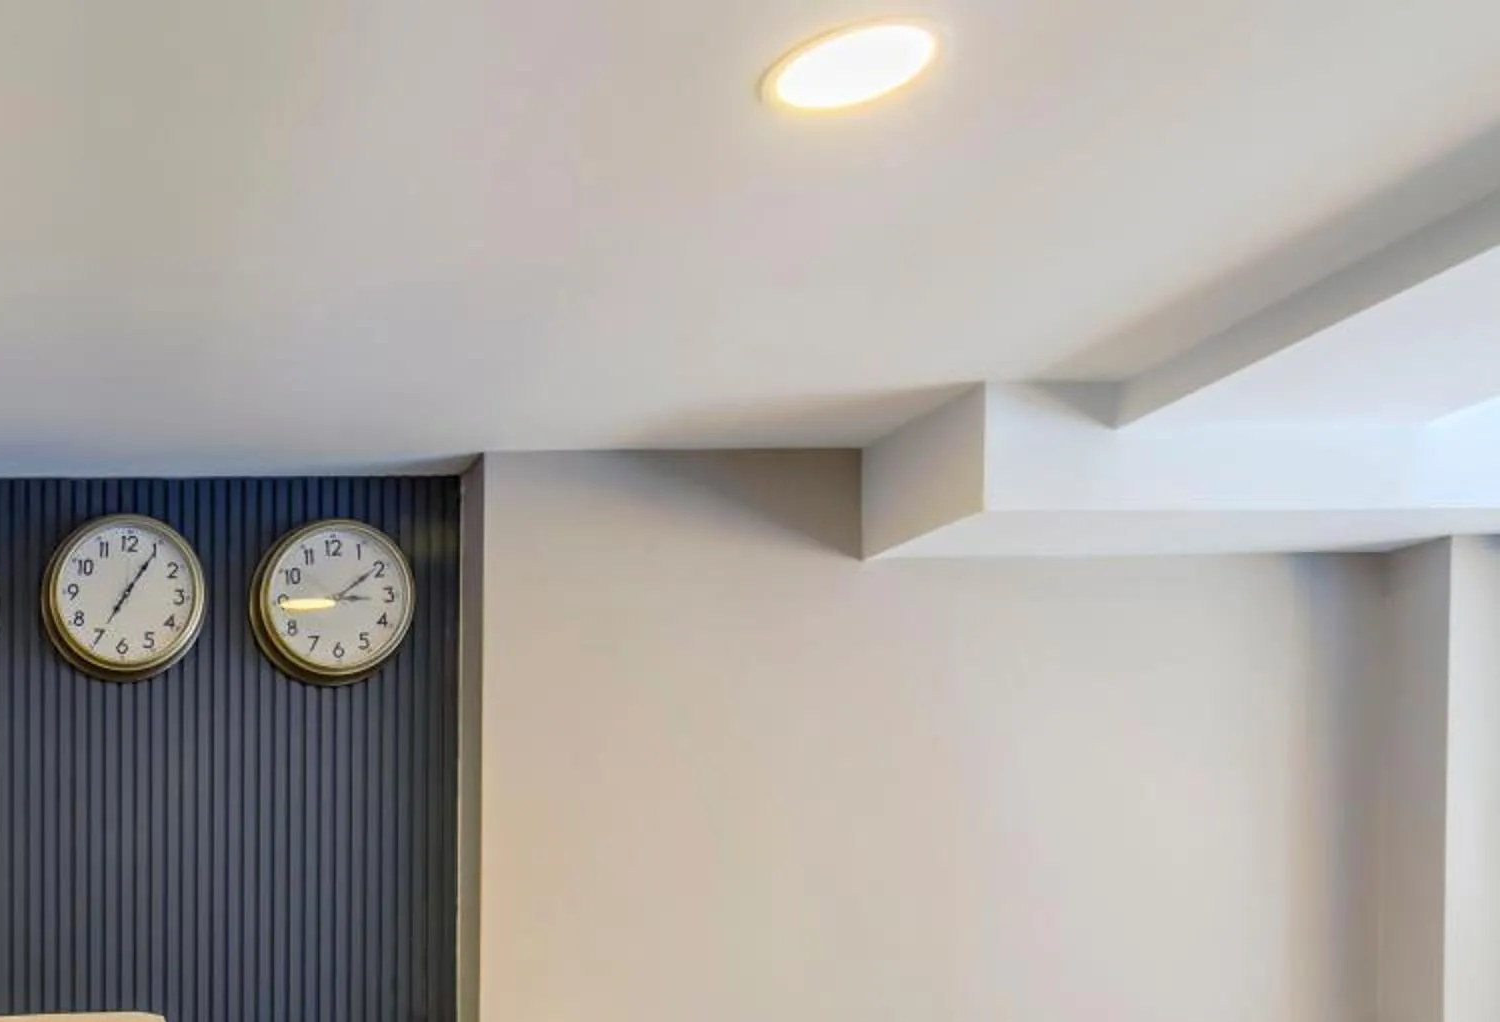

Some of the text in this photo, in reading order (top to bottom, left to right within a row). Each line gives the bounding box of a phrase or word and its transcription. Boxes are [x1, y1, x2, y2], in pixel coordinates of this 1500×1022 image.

[100, 542, 108, 558] 11
[121, 536, 139, 552] 12
[325, 540, 342, 556] 12
[357, 544, 361, 560] 1
[303, 548, 314, 565] 11
[78, 560, 93, 576] 10
[167, 562, 178, 578] 2
[286, 568, 300, 584] 10
[374, 561, 385, 578] 2
[68, 584, 79, 600] 9
[174, 589, 184, 605] 3
[384, 587, 394, 603] 3
[74, 611, 84, 626] 8
[164, 614, 175, 629] 4
[376, 613, 387, 627] 4
[287, 620, 297, 635] 8
[93, 628, 105, 646] 7
[143, 632, 155, 648] 5
[308, 636, 319, 651] 7
[358, 632, 369, 649] 5
[116, 638, 128, 654] 6
[333, 642, 344, 658] 6
